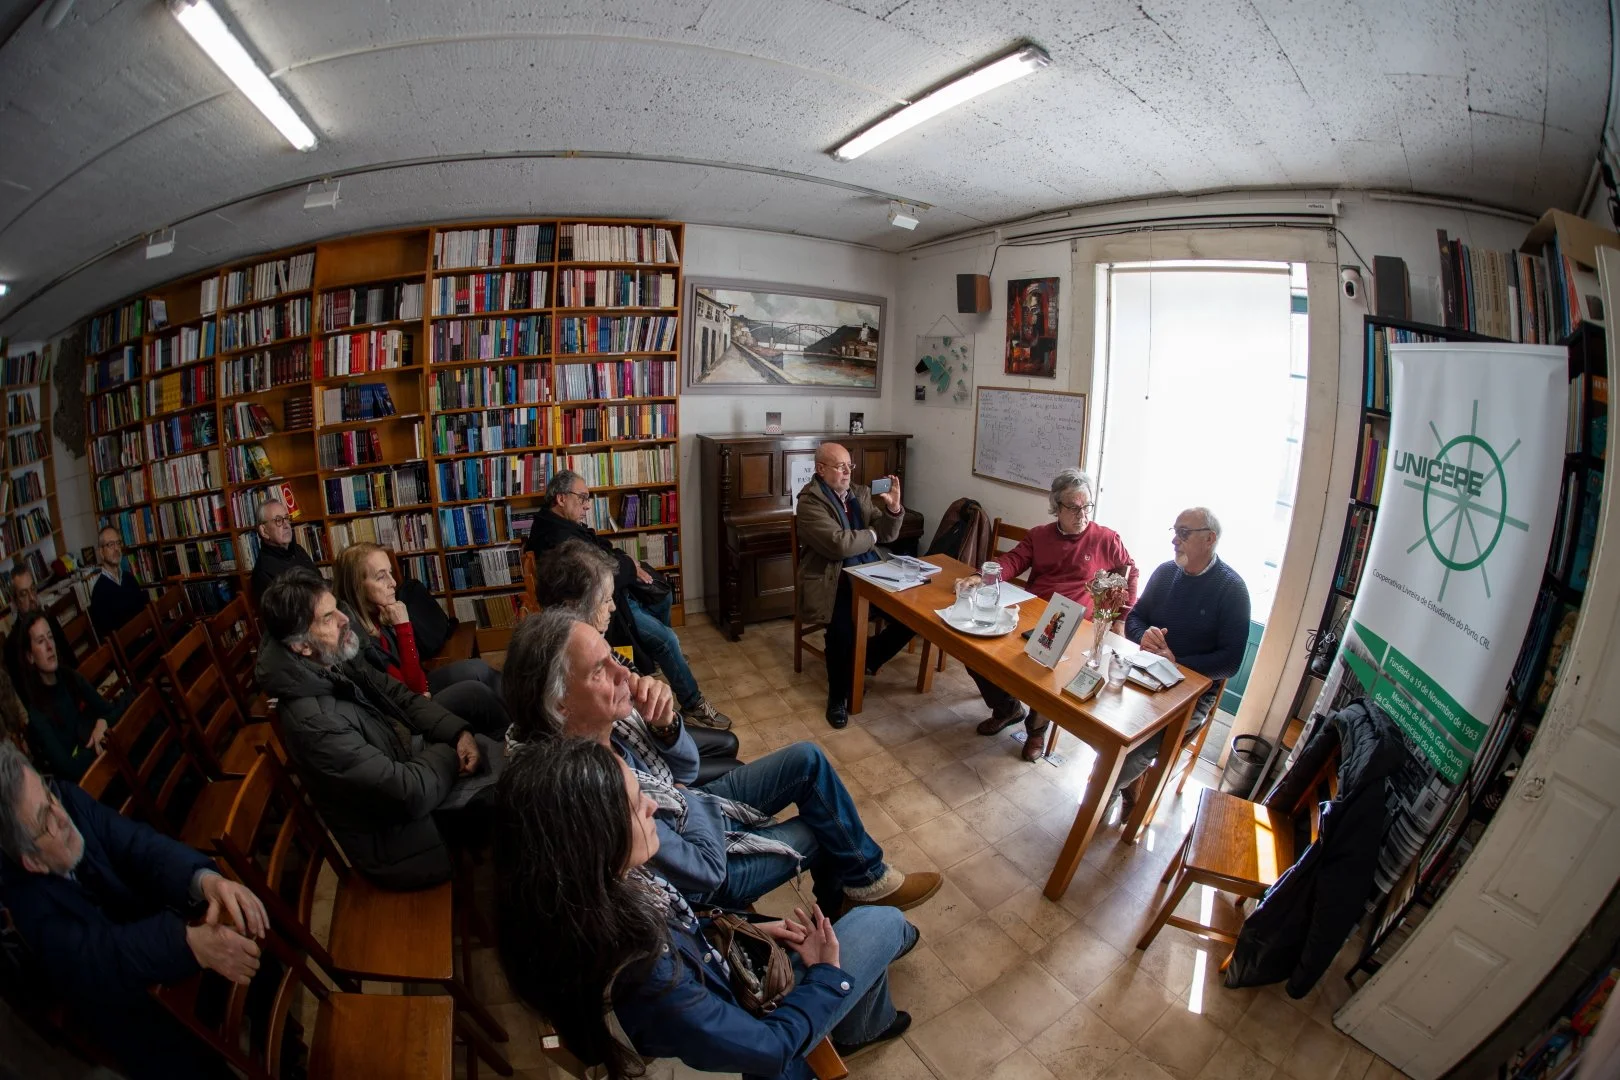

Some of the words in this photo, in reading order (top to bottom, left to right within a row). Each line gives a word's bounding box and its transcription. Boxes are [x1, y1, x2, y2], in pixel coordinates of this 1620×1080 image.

[1394, 450, 1483, 497] UNICEPE
[1373, 569, 1401, 590] Cooperativa
[1401, 584, 1420, 602] Livreira
[1421, 597, 1428, 606] de
[1428, 600, 1456, 624] Estudantes
[1456, 620, 1464, 630] do
[1464, 624, 1479, 642] Porto,
[1480, 636, 1490, 650] CRL
[1375, 693, 1382, 701] da
[1381, 697, 1399, 719] Câmara
[1399, 715, 1422, 743] Municipal
[1421, 740, 1429, 750] do
[1428, 746, 1441, 767] Porto,
[1441, 762, 1459, 780] 2014
[1389, 657, 1410, 679] Fundada
[1414, 678, 1422, 688] 19
[1421, 684, 1429, 695] de
[1428, 690, 1455, 721] Novembro
[1453, 717, 1461, 728] de
[1461, 723, 1479, 741] 1963
[1391, 692, 1412, 715] Medalha
[1411, 712, 1420, 722] de
[1419, 717, 1435, 741] Mérito,
[1434, 736, 1447, 753] Grau
[1446, 749, 1463, 769] Ouro,
